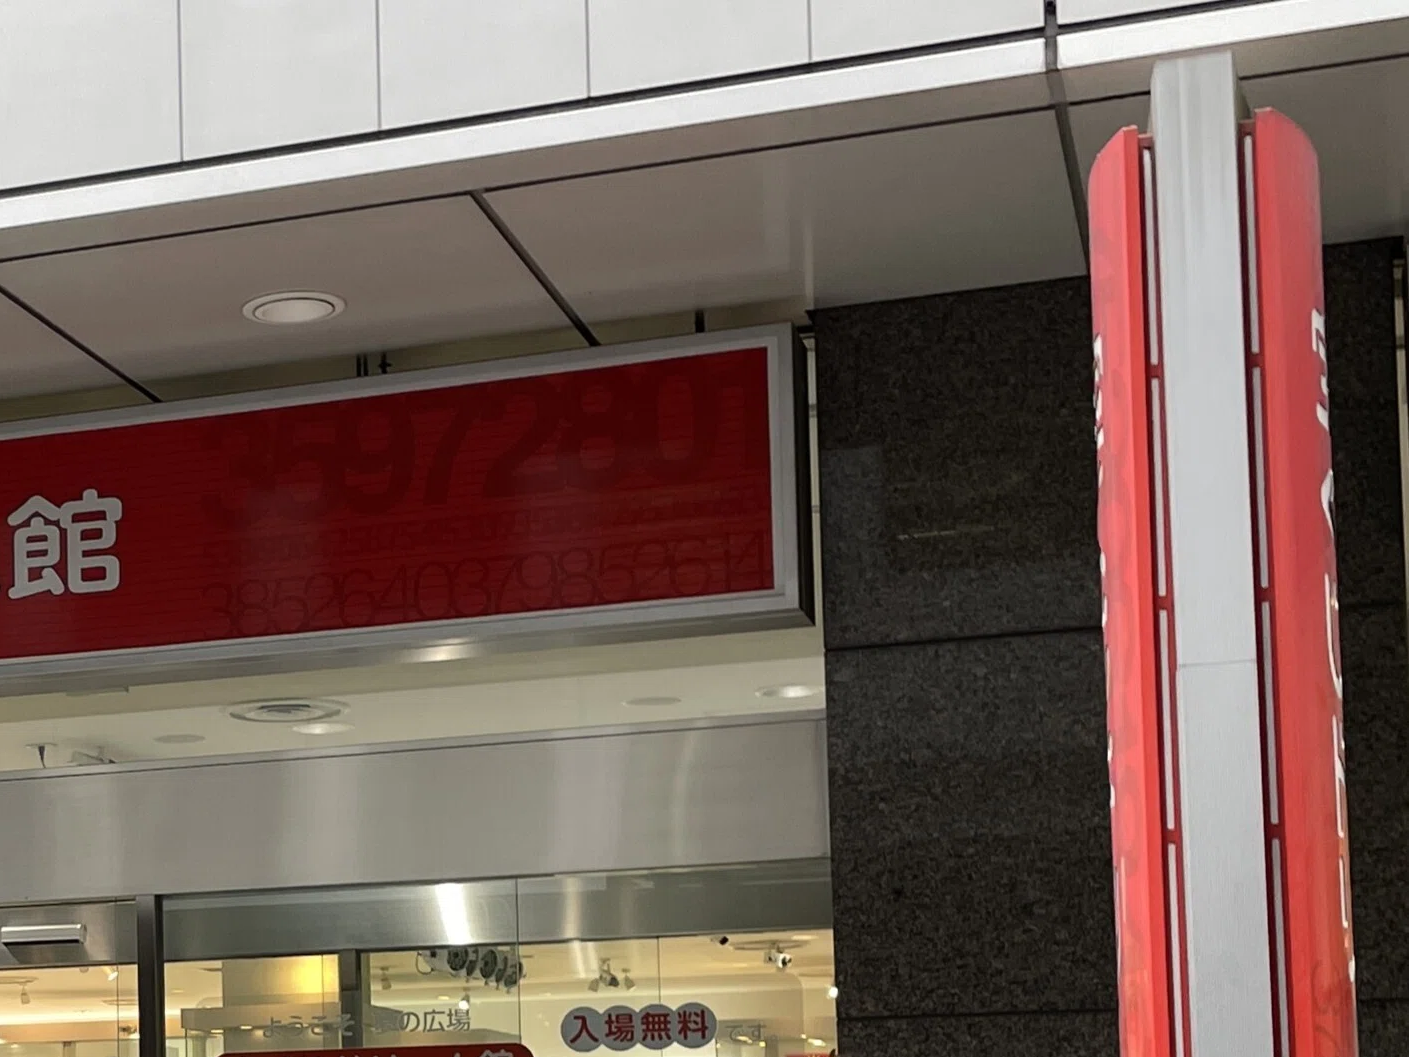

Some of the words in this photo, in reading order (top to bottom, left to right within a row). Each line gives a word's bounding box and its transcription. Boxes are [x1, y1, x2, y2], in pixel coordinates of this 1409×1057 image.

[263, 1013, 355, 1038] ようこそ
[570, 1009, 709, 1043] 入場無料
